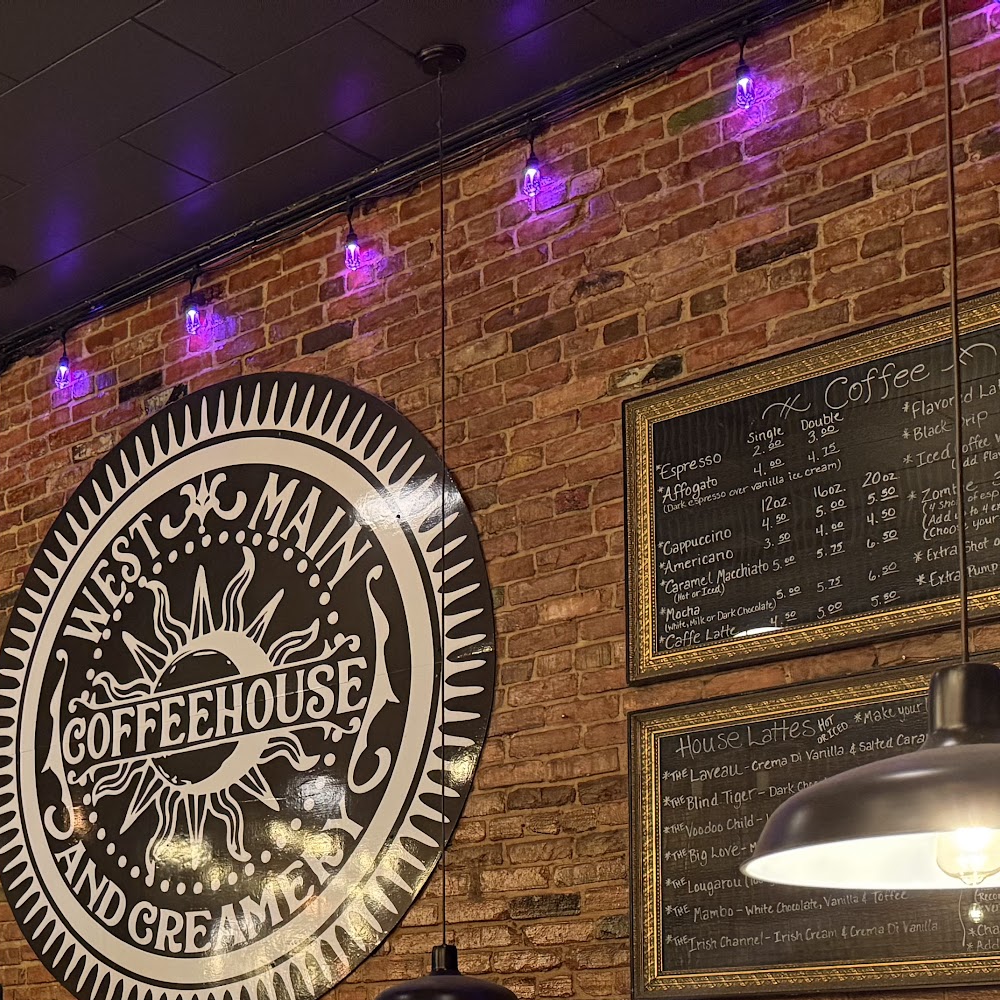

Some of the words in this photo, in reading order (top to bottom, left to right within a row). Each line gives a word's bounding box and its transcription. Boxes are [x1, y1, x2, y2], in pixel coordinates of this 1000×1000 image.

[825, 363, 930, 409] Coffee
[912, 386, 972, 419] Flavord
[747, 427, 784, 443] Single
[801, 412, 843, 430] Double
[913, 420, 951, 440] Black
[659, 453, 722, 479] Espresso
[753, 440, 784, 457] 2.00
[808, 426, 839, 443] 3.00
[916, 443, 951, 467] Iced
[663, 476, 718, 503] Affogato
[754, 458, 784, 476] 4.00
[729, 486, 749, 497] over
[751, 475, 784, 491] vanilla
[789, 471, 802, 480] ice
[805, 460, 841, 477] cream)
[663, 528, 731, 555] Cappuccino
[815, 499, 847, 518] 5.00
[62, 513, 162, 643] WEST
[249, 471, 373, 590] MAIN
[664, 550, 734, 575] Americano
[816, 521, 845, 537] 4.00
[927, 545, 957, 561] Extra
[665, 572, 712, 594] Caramel
[717, 559, 769, 583] Macchiato
[772, 555, 796, 571] 5.00
[930, 571, 961, 587] Extra
[967, 562, 998, 578] Pump
[666, 606, 700, 622] Mocha
[776, 586, 801, 600] 5.00
[692, 590, 700, 598] or
[690, 615, 705, 628] Milk
[717, 607, 736, 621] Dark
[665, 630, 700, 649] Caffe
[706, 624, 736, 640] Latte
[62, 656, 368, 766] COFFEEHOUSE
[864, 706, 896, 724] Make
[898, 702, 922, 722] your
[676, 731, 742, 759] House
[748, 720, 816, 746] Lattes
[828, 722, 848, 738] ICED
[670, 768, 688, 782] THE
[690, 763, 743, 782] Laveau
[752, 757, 787, 771] Crema
[806, 746, 844, 761] Vanilla
[859, 737, 893, 752] Salted
[896, 733, 928, 746] Cara
[670, 795, 685, 808] THE
[686, 793, 718, 810] Blind
[722, 788, 757, 809] Tiger
[769, 783, 794, 797] Dark
[670, 823, 685, 834] THE
[685, 821, 723, 838] Voodoo
[727, 813, 754, 831] Child
[672, 848, 687, 861] THE
[688, 850, 707, 866] Big
[54, 840, 126, 927] AND
[127, 798, 363, 954] CREAMERY
[672, 877, 687, 889] THE
[688, 878, 741, 896] Lougarou
[673, 904, 690, 917] THE
[694, 906, 733, 922] Mambo
[745, 904, 773, 916] White
[823, 895, 859, 907] Vanilla
[674, 935, 688, 947] THE
[688, 937, 717, 952] Irish
[720, 932, 763, 947] Channel
[774, 930, 803, 943] Irish
[805, 928, 837, 940] Cream
[850, 925, 884, 938] Crema
[903, 919, 938, 933] Vanilla
